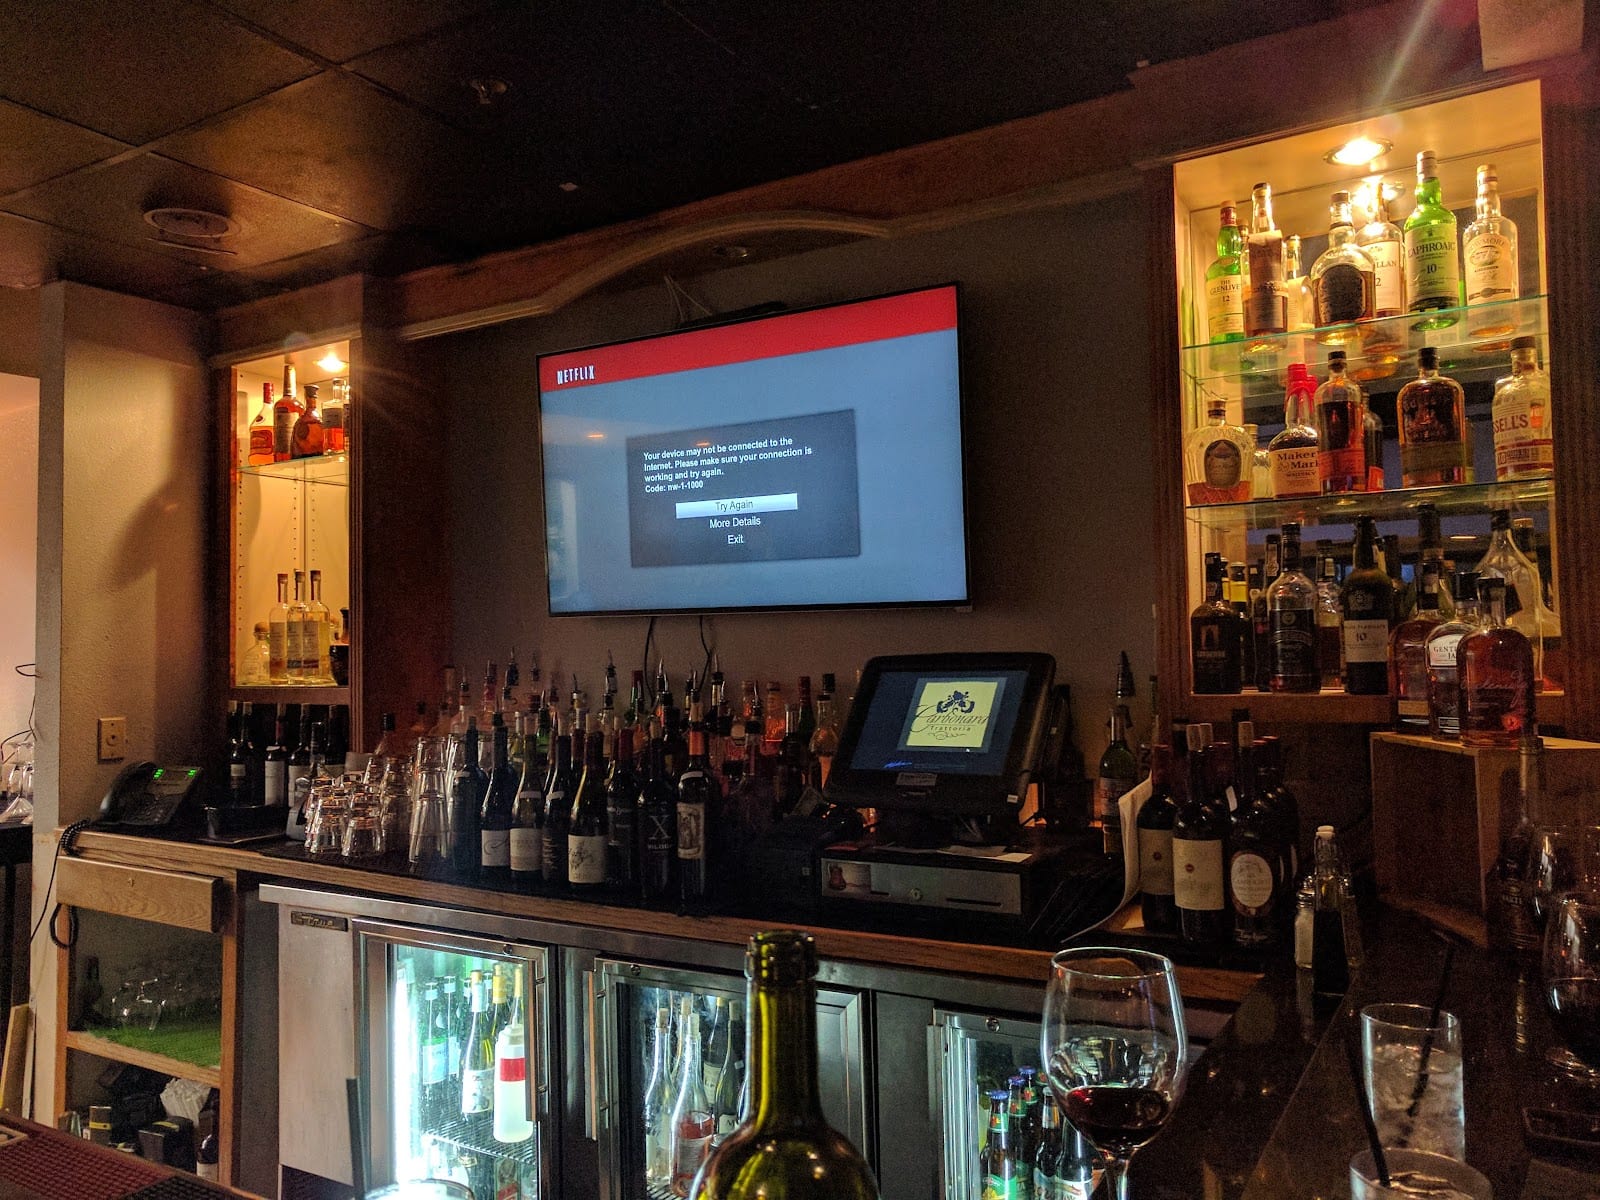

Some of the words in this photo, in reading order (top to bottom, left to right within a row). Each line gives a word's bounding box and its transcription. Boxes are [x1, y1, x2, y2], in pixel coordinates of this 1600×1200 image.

[1427, 263, 1437, 273] 10
[1210, 283, 1241, 295] GLENLIVE
[557, 365, 595, 385] NETFLIX
[1493, 414, 1528, 433] SELL'S
[643, 452, 660, 460] Your
[661, 449, 684, 459] device
[686, 448, 701, 457] may
[703, 445, 715, 454] not
[717, 444, 726, 453] be
[728, 439, 768, 452] connected
[770, 439, 778, 447] to
[780, 437, 793, 445] the
[674, 460, 698, 469] Please
[700, 457, 719, 466] make
[739, 454, 757, 463] your
[759, 448, 802, 459] connection
[804, 446, 812, 455] is
[644, 473, 673, 482] working
[674, 470, 688, 479] and
[690, 470, 700, 479] try
[701, 467, 724, 478] again.
[645, 484, 666, 493] Code:
[667, 480, 704, 491] nw-1-1000
[715, 502, 728, 512] Try
[729, 500, 754, 511] Again
[709, 519, 730, 529] More
[732, 516, 761, 527] Details
[727, 534, 743, 544] Exit
